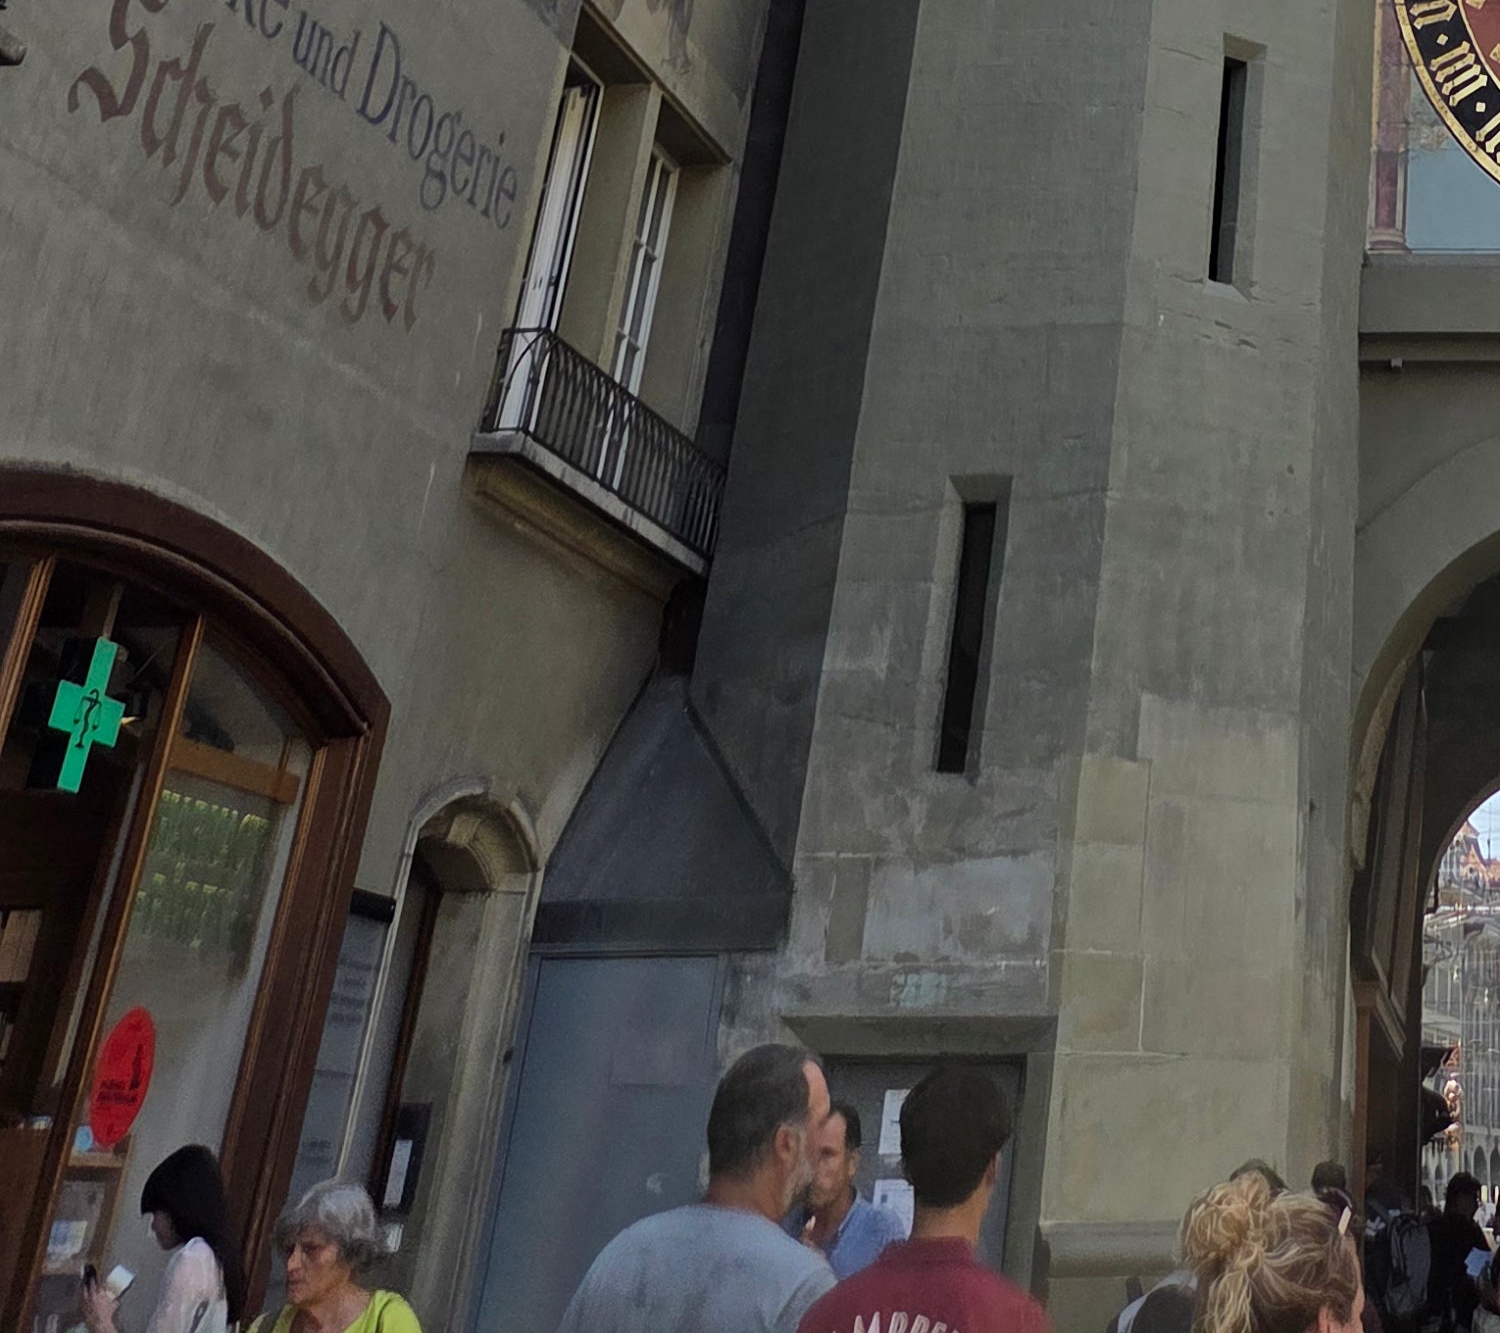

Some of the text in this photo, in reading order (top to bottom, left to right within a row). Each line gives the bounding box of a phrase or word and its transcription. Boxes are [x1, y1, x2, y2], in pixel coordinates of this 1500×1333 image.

[292, 10, 363, 103] und
[356, 19, 519, 231] Drogerie
[1429, 40, 1488, 107] IIII
